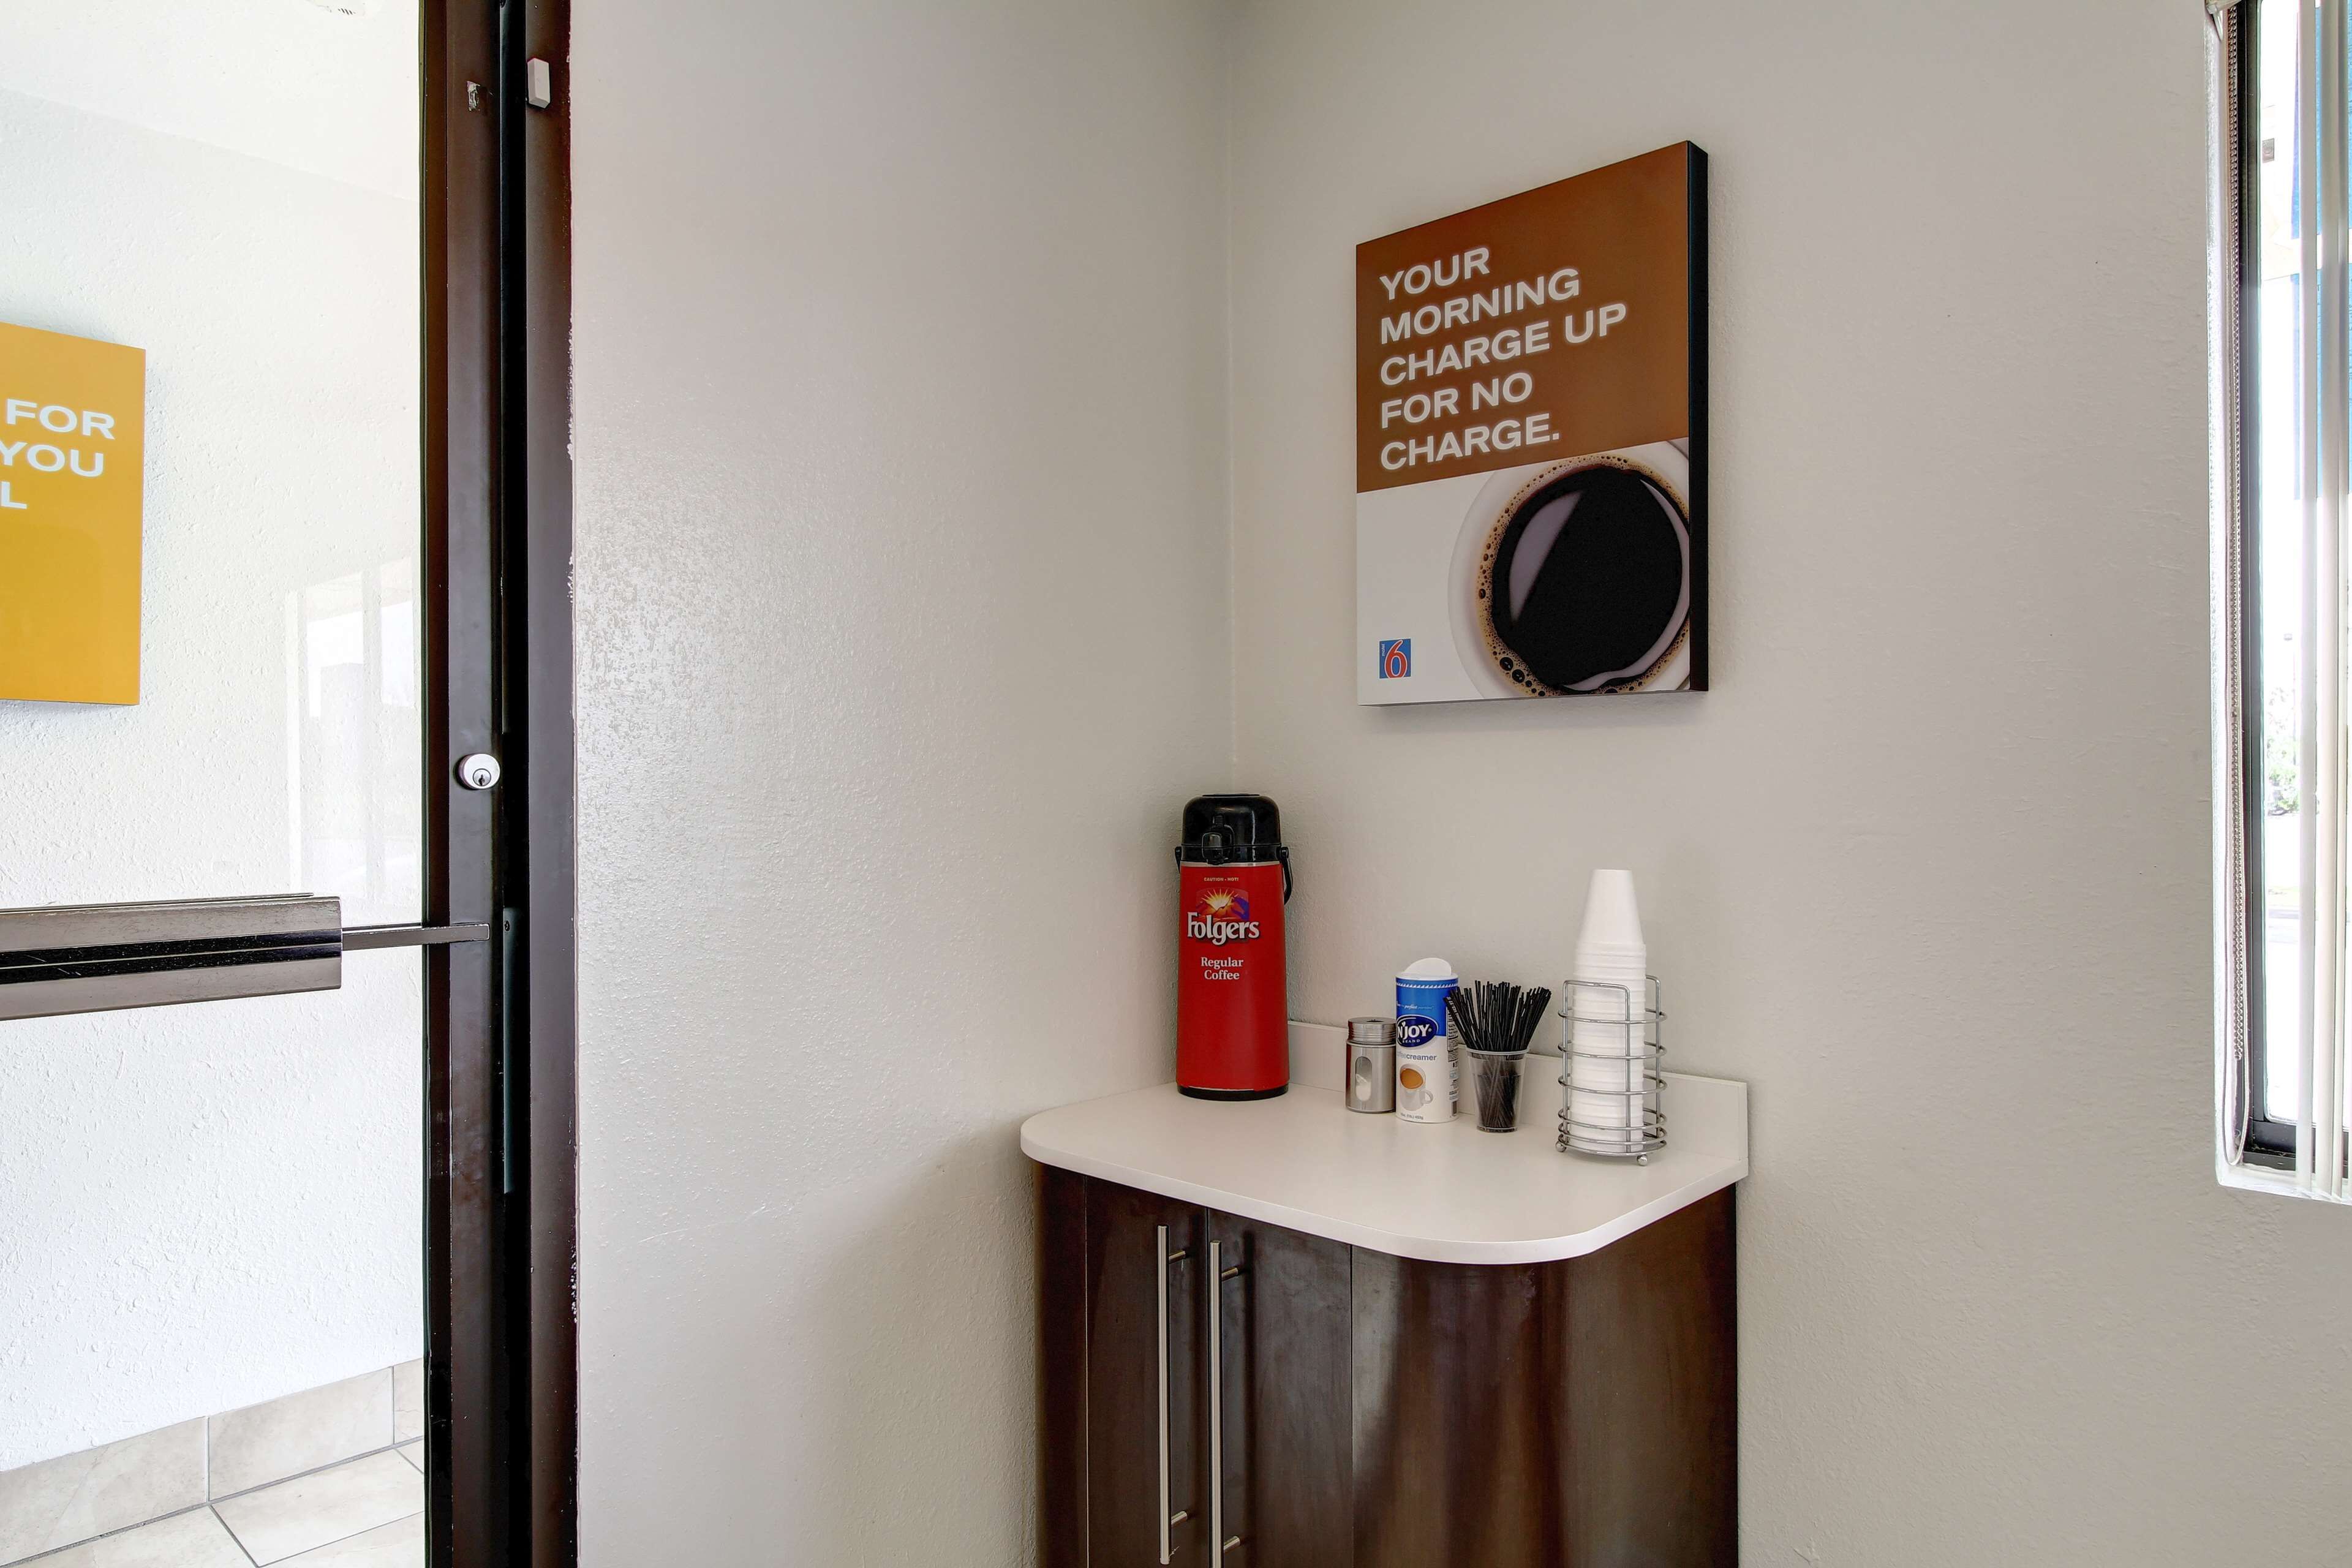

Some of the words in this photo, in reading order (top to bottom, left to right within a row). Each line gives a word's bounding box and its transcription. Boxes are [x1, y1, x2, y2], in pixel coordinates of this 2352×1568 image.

[1379, 247, 1490, 301] YOUR
[1381, 268, 1580, 344] MORNING
[1380, 321, 1550, 386] CHARGE
[1565, 303, 1627, 344] UP
[6, 398, 115, 440] FOR
[1381, 388, 1459, 429] FOR
[1472, 372, 1533, 410] NO
[0, 439, 104, 478] YOU
[1380, 413, 1560, 470] CHARGE.
[1384, 639, 1408, 679] 6
[1187, 911, 1260, 946] Folgers
[1200, 957, 1244, 969] Regular
[1204, 970, 1240, 980] Coffee
